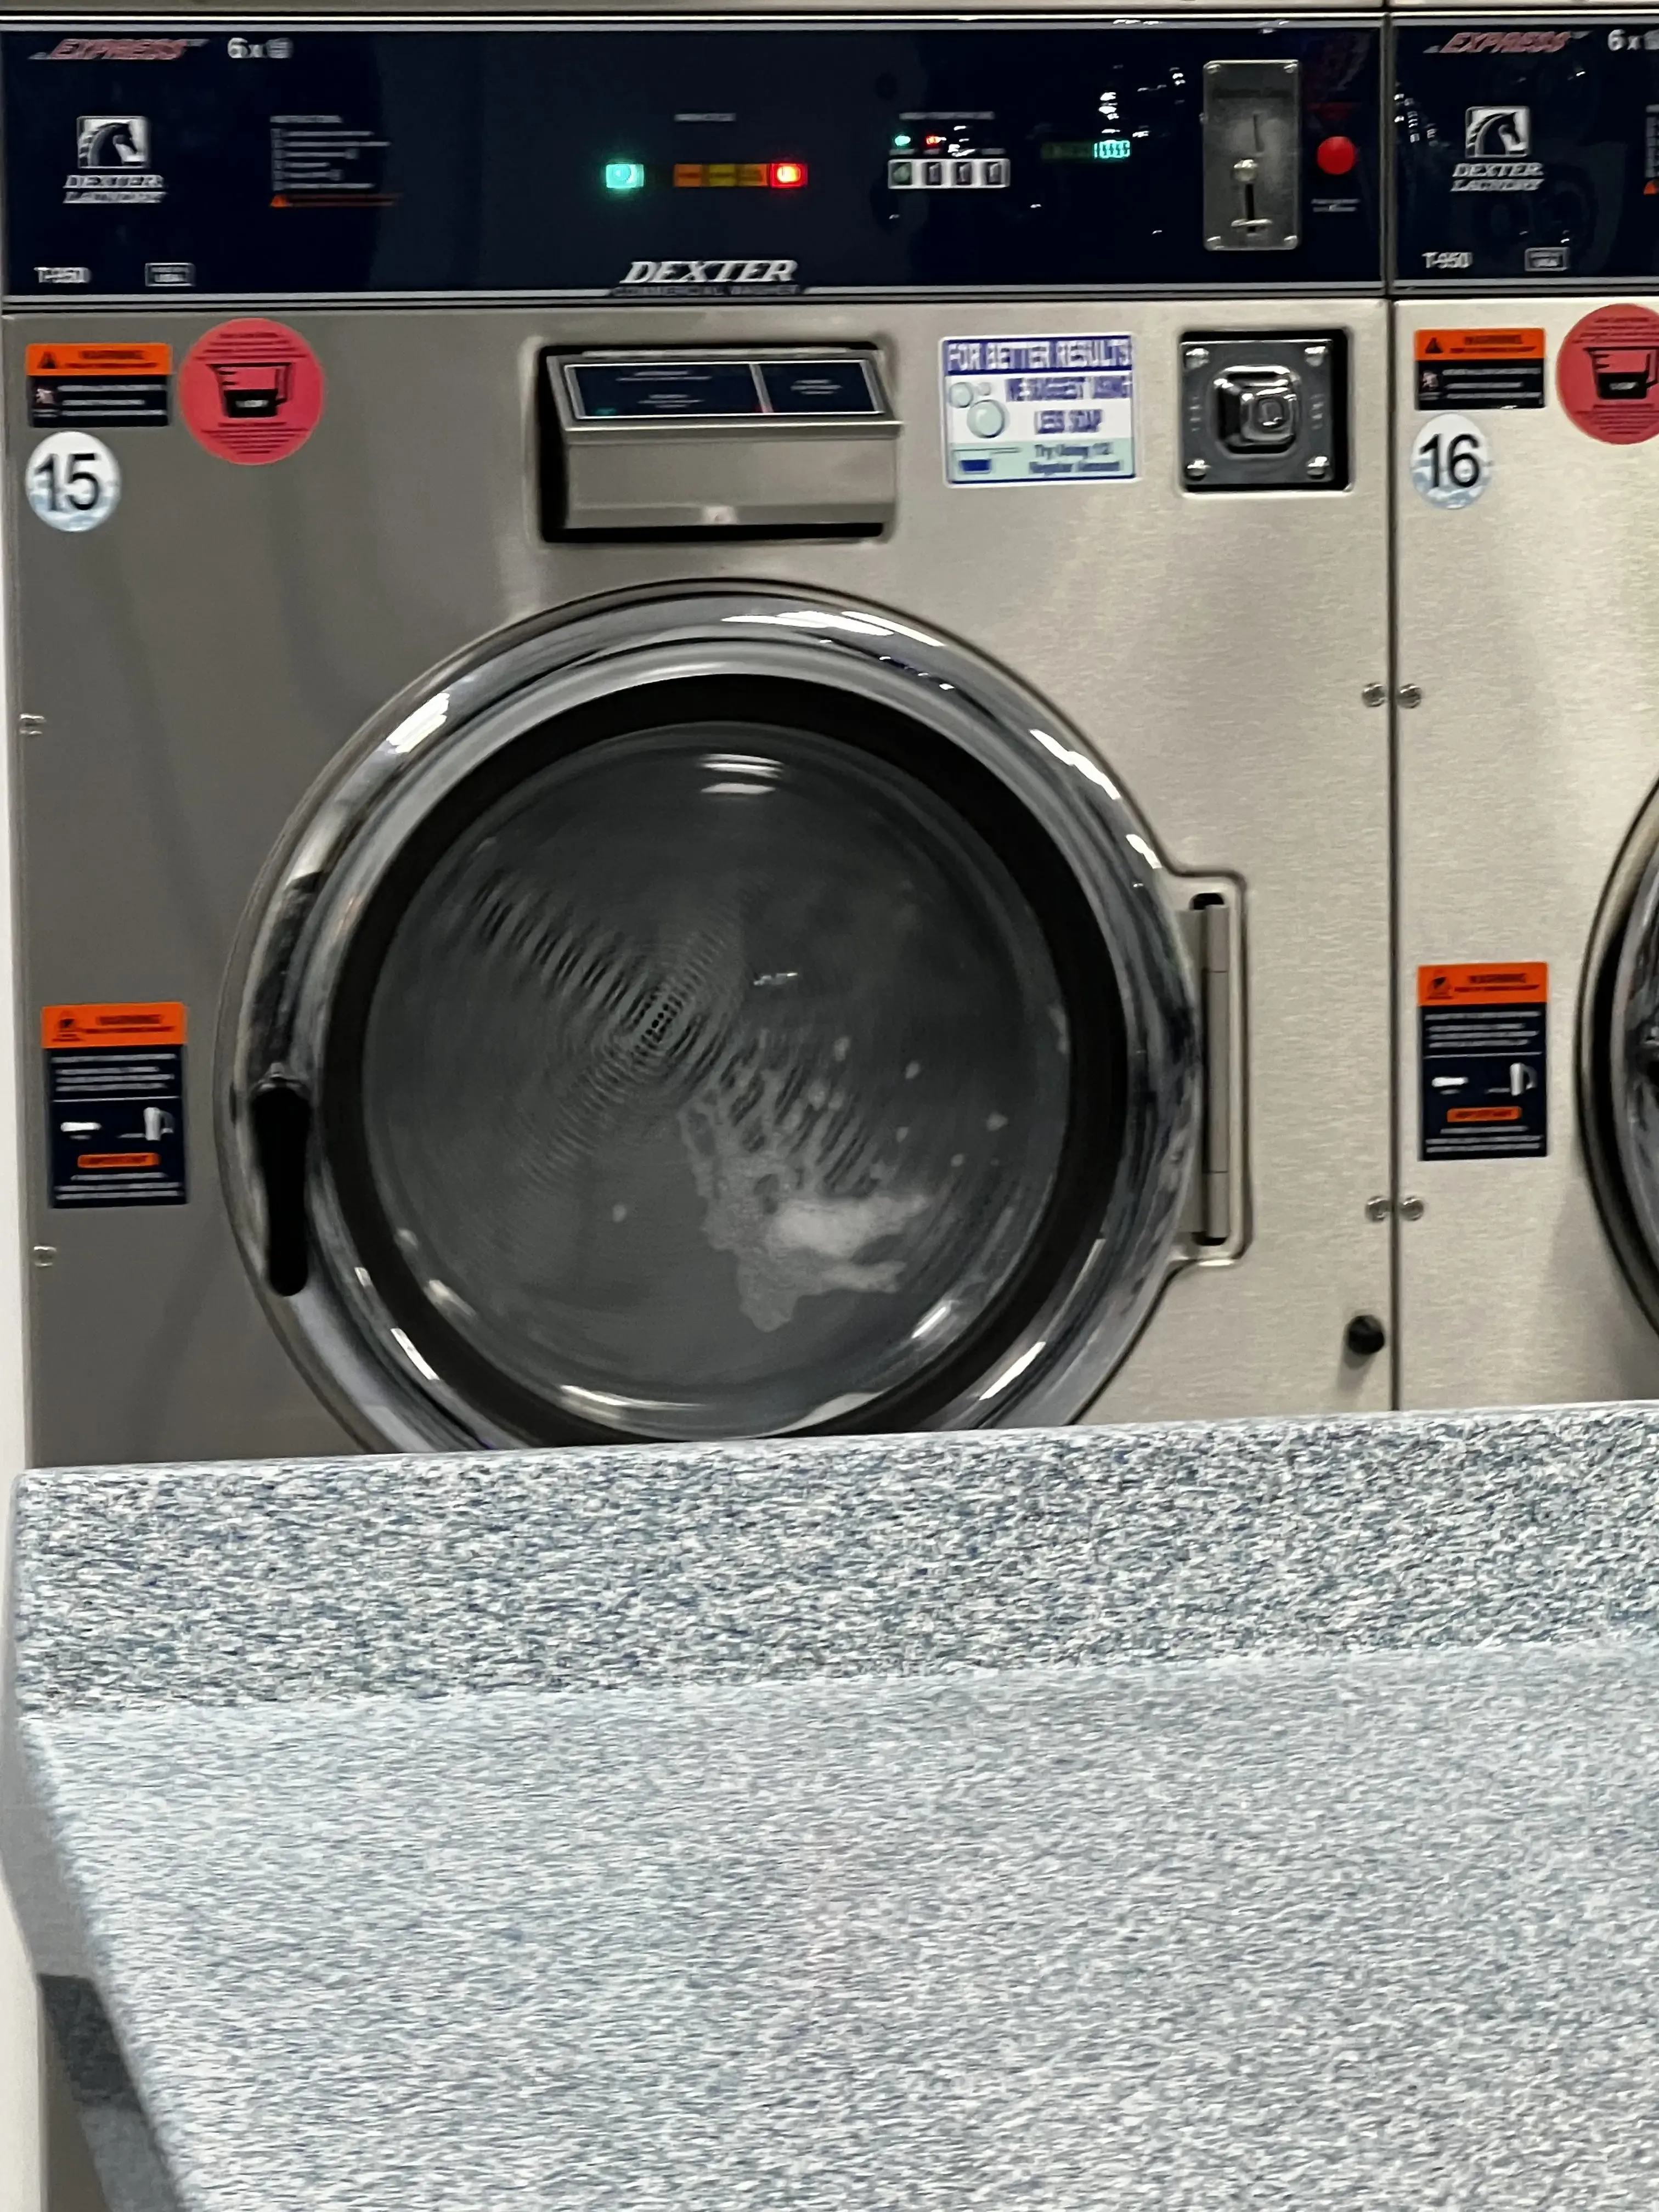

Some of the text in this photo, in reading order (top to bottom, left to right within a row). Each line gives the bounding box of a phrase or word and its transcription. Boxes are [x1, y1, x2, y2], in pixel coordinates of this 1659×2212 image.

[1440, 31, 1571, 53] EXPRESS
[1452, 162, 1545, 178] DEXTER
[619, 259, 799, 284] DEXTER
[949, 338, 1132, 371] FOR BETTER RESULTS
[1420, 433, 1480, 488] 16
[36, 452, 102, 511] 15
